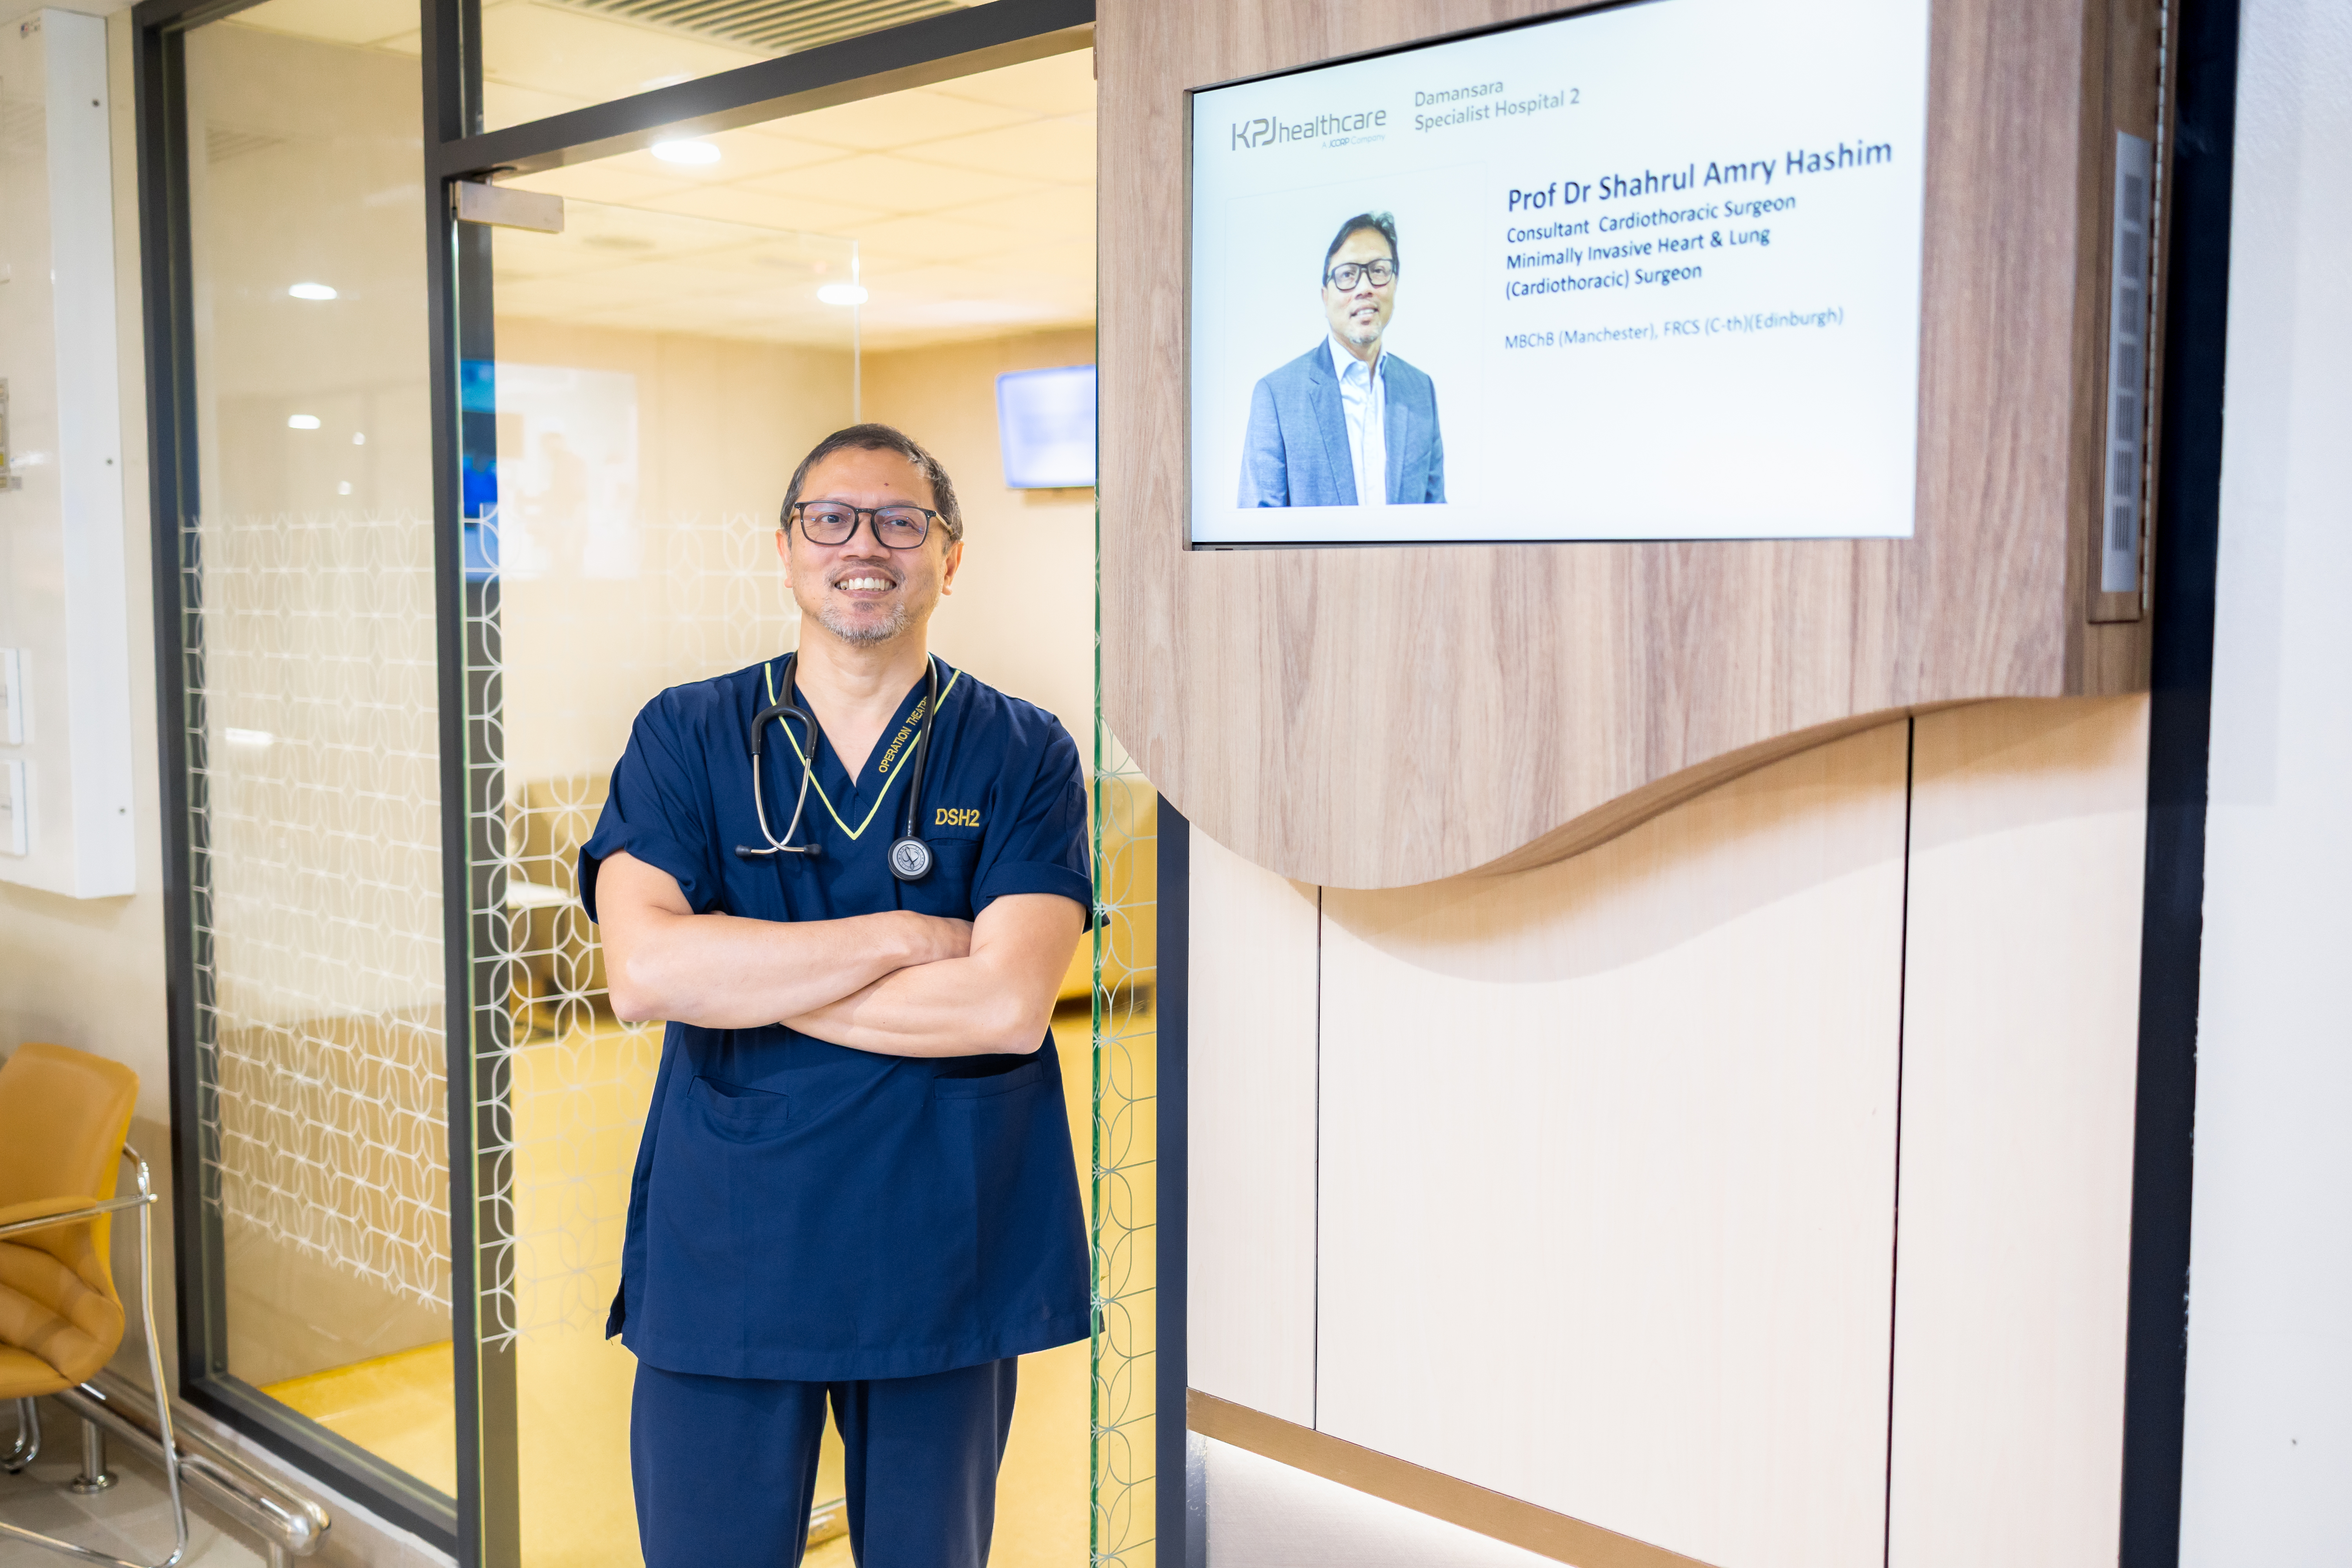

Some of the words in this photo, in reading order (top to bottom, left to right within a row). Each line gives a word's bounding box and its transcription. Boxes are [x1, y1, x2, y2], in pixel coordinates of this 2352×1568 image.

[1415, 81, 1504, 107] Damansara
[1415, 105, 1490, 133] Specialist
[1495, 89, 1564, 116] Hospital
[1570, 87, 1580, 105] 2
[1351, 134, 1385, 145] Company
[1508, 182, 1557, 212] Prof
[1564, 181, 1592, 205] Dr
[1599, 163, 1695, 201] Shahrul
[1704, 160, 1776, 186] Amry
[1786, 140, 1892, 176] Hashim
[1507, 220, 1590, 243] Consultant
[1599, 204, 1719, 232] Cardiothoracic
[1724, 196, 1796, 218] Surgeon
[1507, 248, 1583, 269] Minimally
[1588, 241, 1652, 261] Invasive
[1658, 234, 1704, 252] Heart
[1710, 230, 1723, 248] &
[1730, 229, 1770, 247] Lung
[1506, 269, 1630, 300] (Cardiothoracic)
[1635, 266, 1702, 286] Surgeon
[1505, 331, 1554, 348] MBChB
[1559, 323, 1658, 347] (Manchester),
[1664, 319, 1700, 336] FRCS
[878, 726, 912, 773] OPERATION
[935, 808, 980, 827] DSH2
